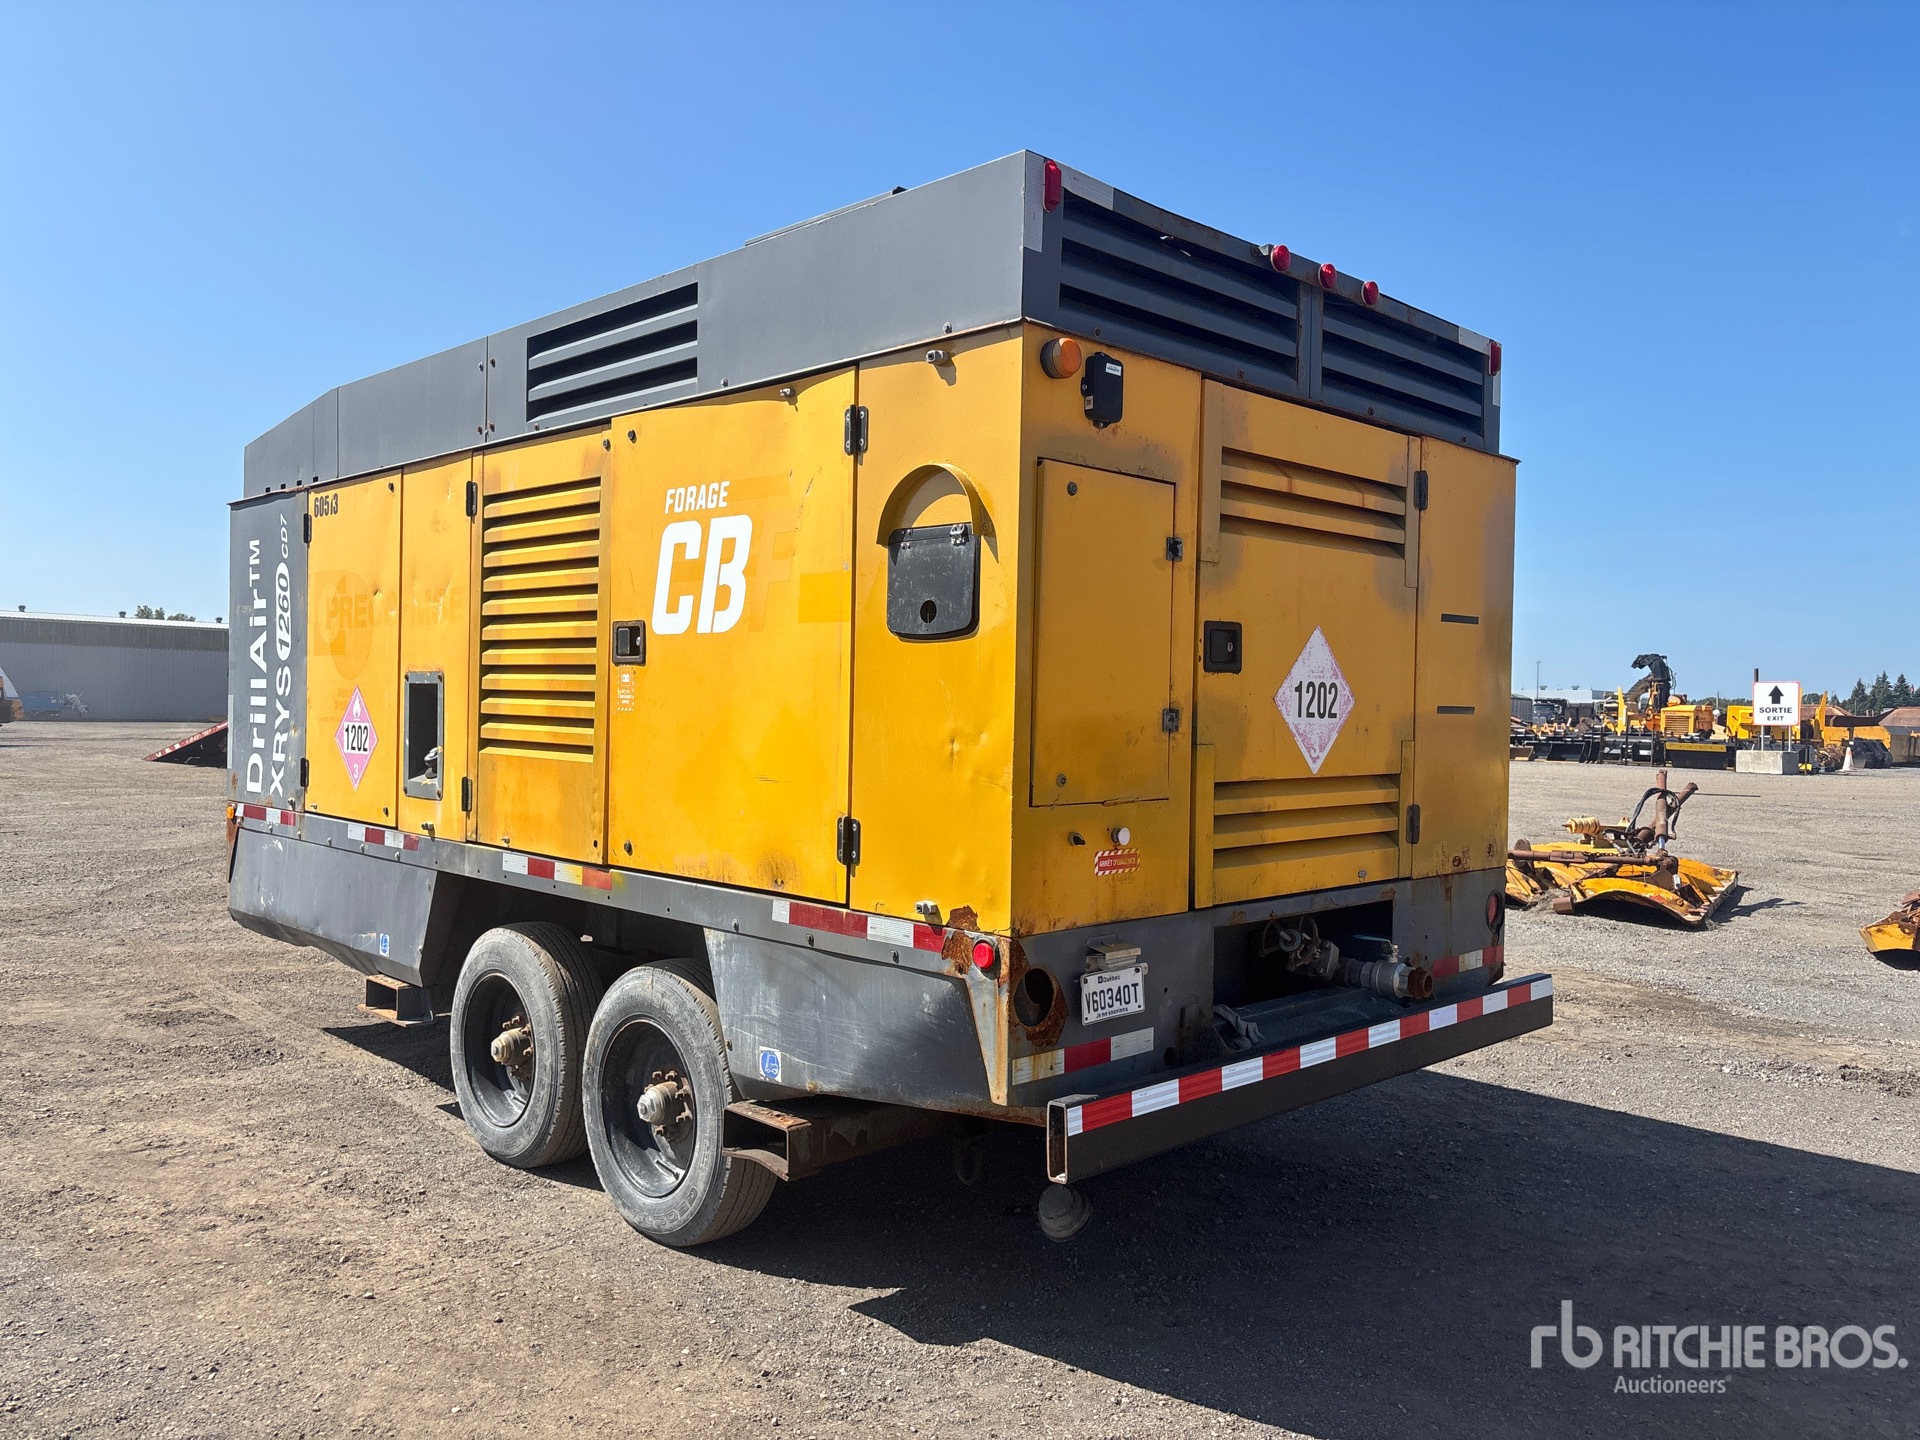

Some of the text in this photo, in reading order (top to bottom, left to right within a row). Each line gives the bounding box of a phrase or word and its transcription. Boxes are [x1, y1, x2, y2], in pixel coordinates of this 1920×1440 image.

[664, 480, 730, 514] FORAGE
[651, 514, 753, 635] CB
[269, 513, 292, 798] XRYS 1260 CD7
[1294, 680, 1339, 719] 1202
[345, 724, 369, 752] 1202
[353, 763, 359, 779] 3
[1100, 857, 1136, 867] ARRÊT D'URGENCE
[1085, 983, 1139, 1014] V60340T
[1108, 1007, 1128, 1016] souviens
